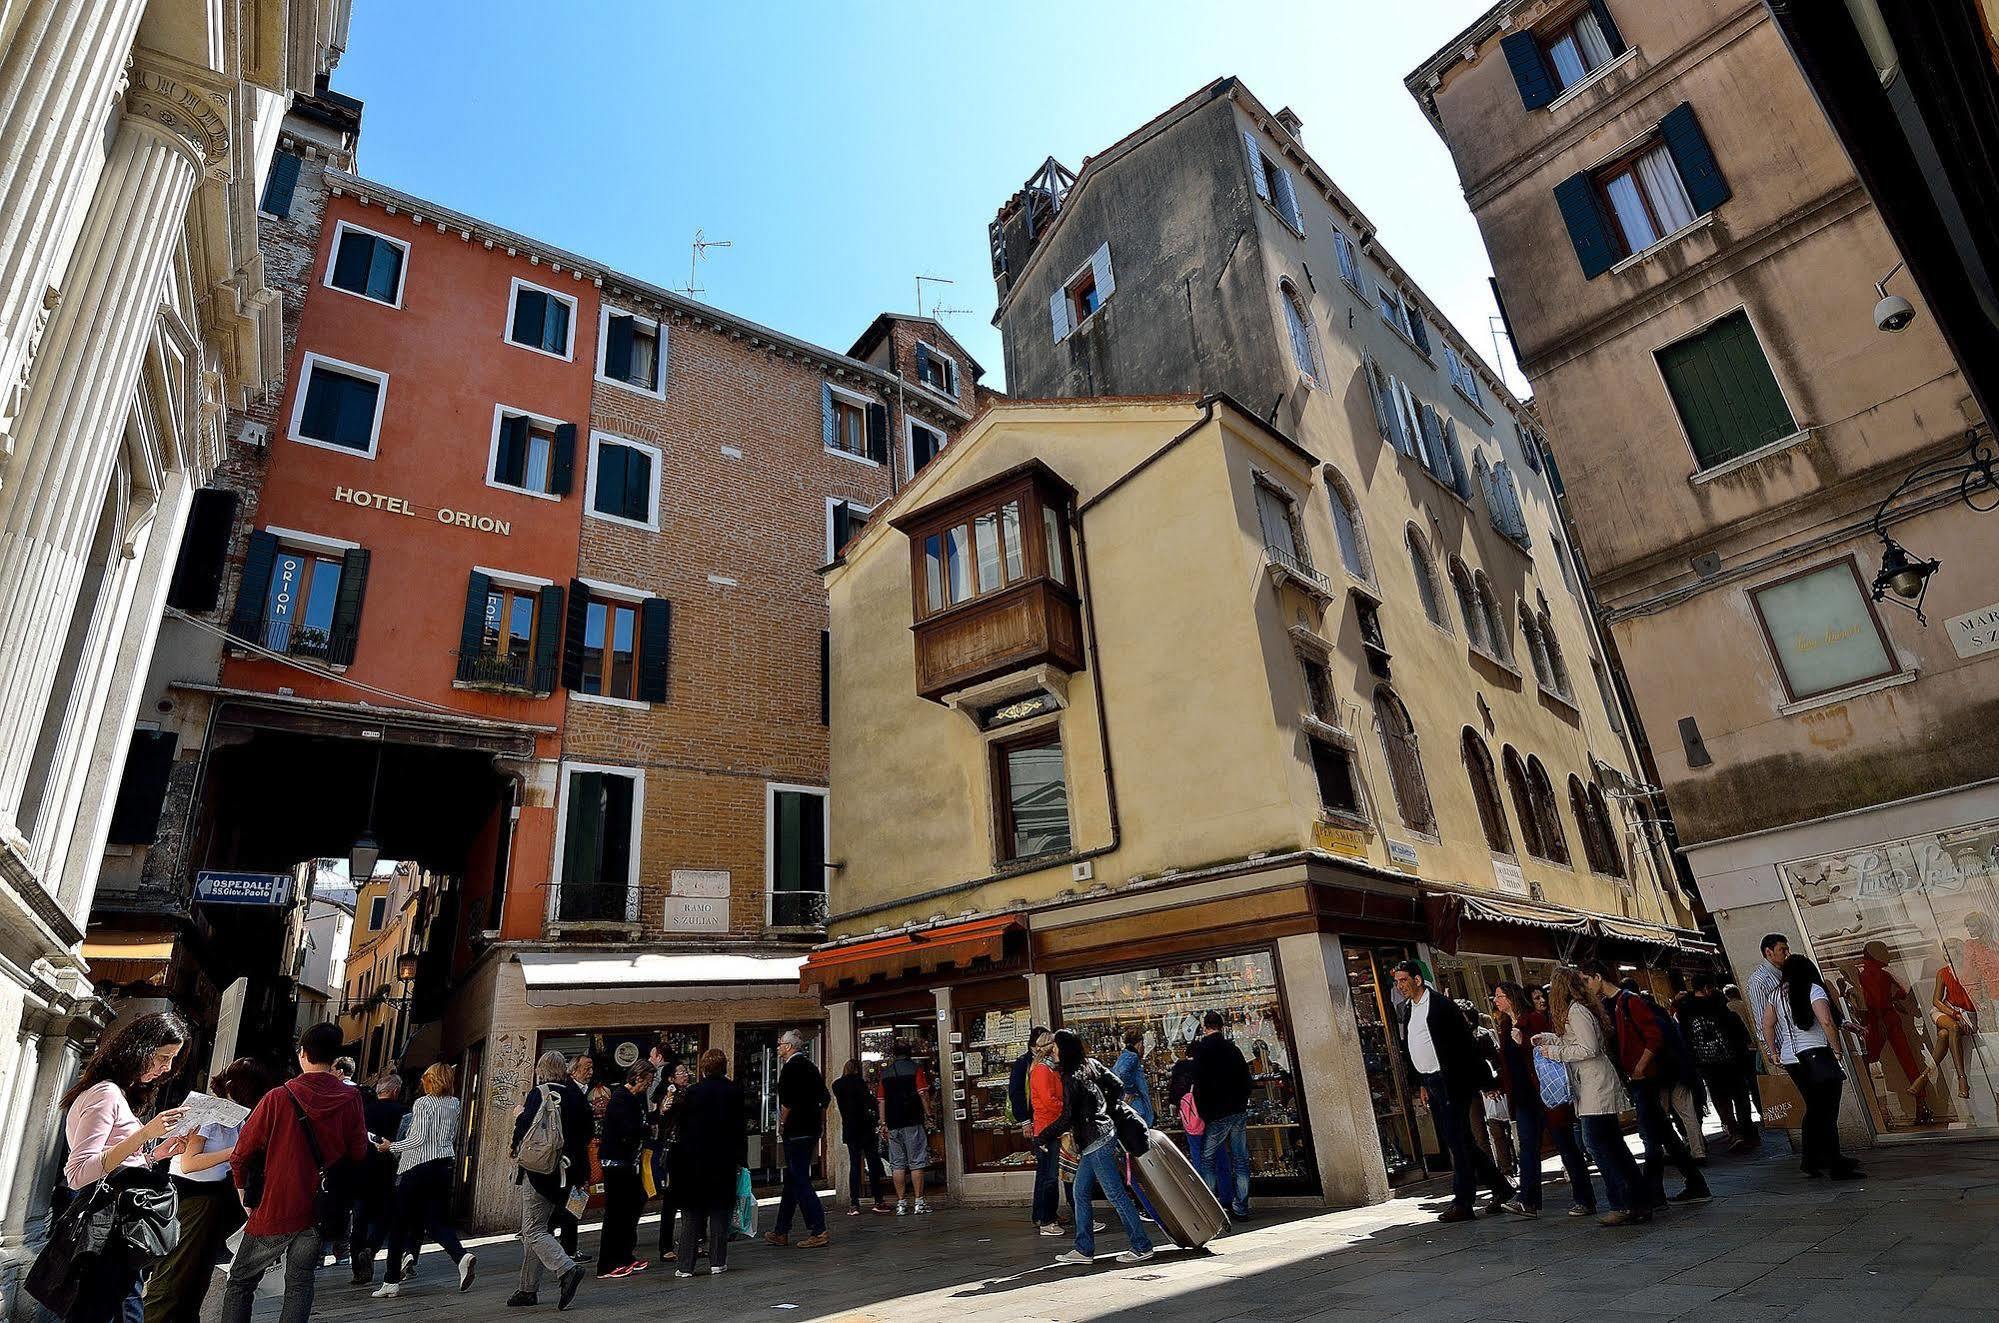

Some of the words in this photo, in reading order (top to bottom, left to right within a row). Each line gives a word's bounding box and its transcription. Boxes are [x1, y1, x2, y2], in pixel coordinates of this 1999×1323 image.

[335, 486, 416, 517] HOTEL
[437, 508, 512, 537] ORION
[276, 560, 297, 615] ORION
[213, 880, 272, 890] OSPEDALE
[684, 904, 712, 913] RAMO
[1767, 1102, 1793, 1114] SHOES
